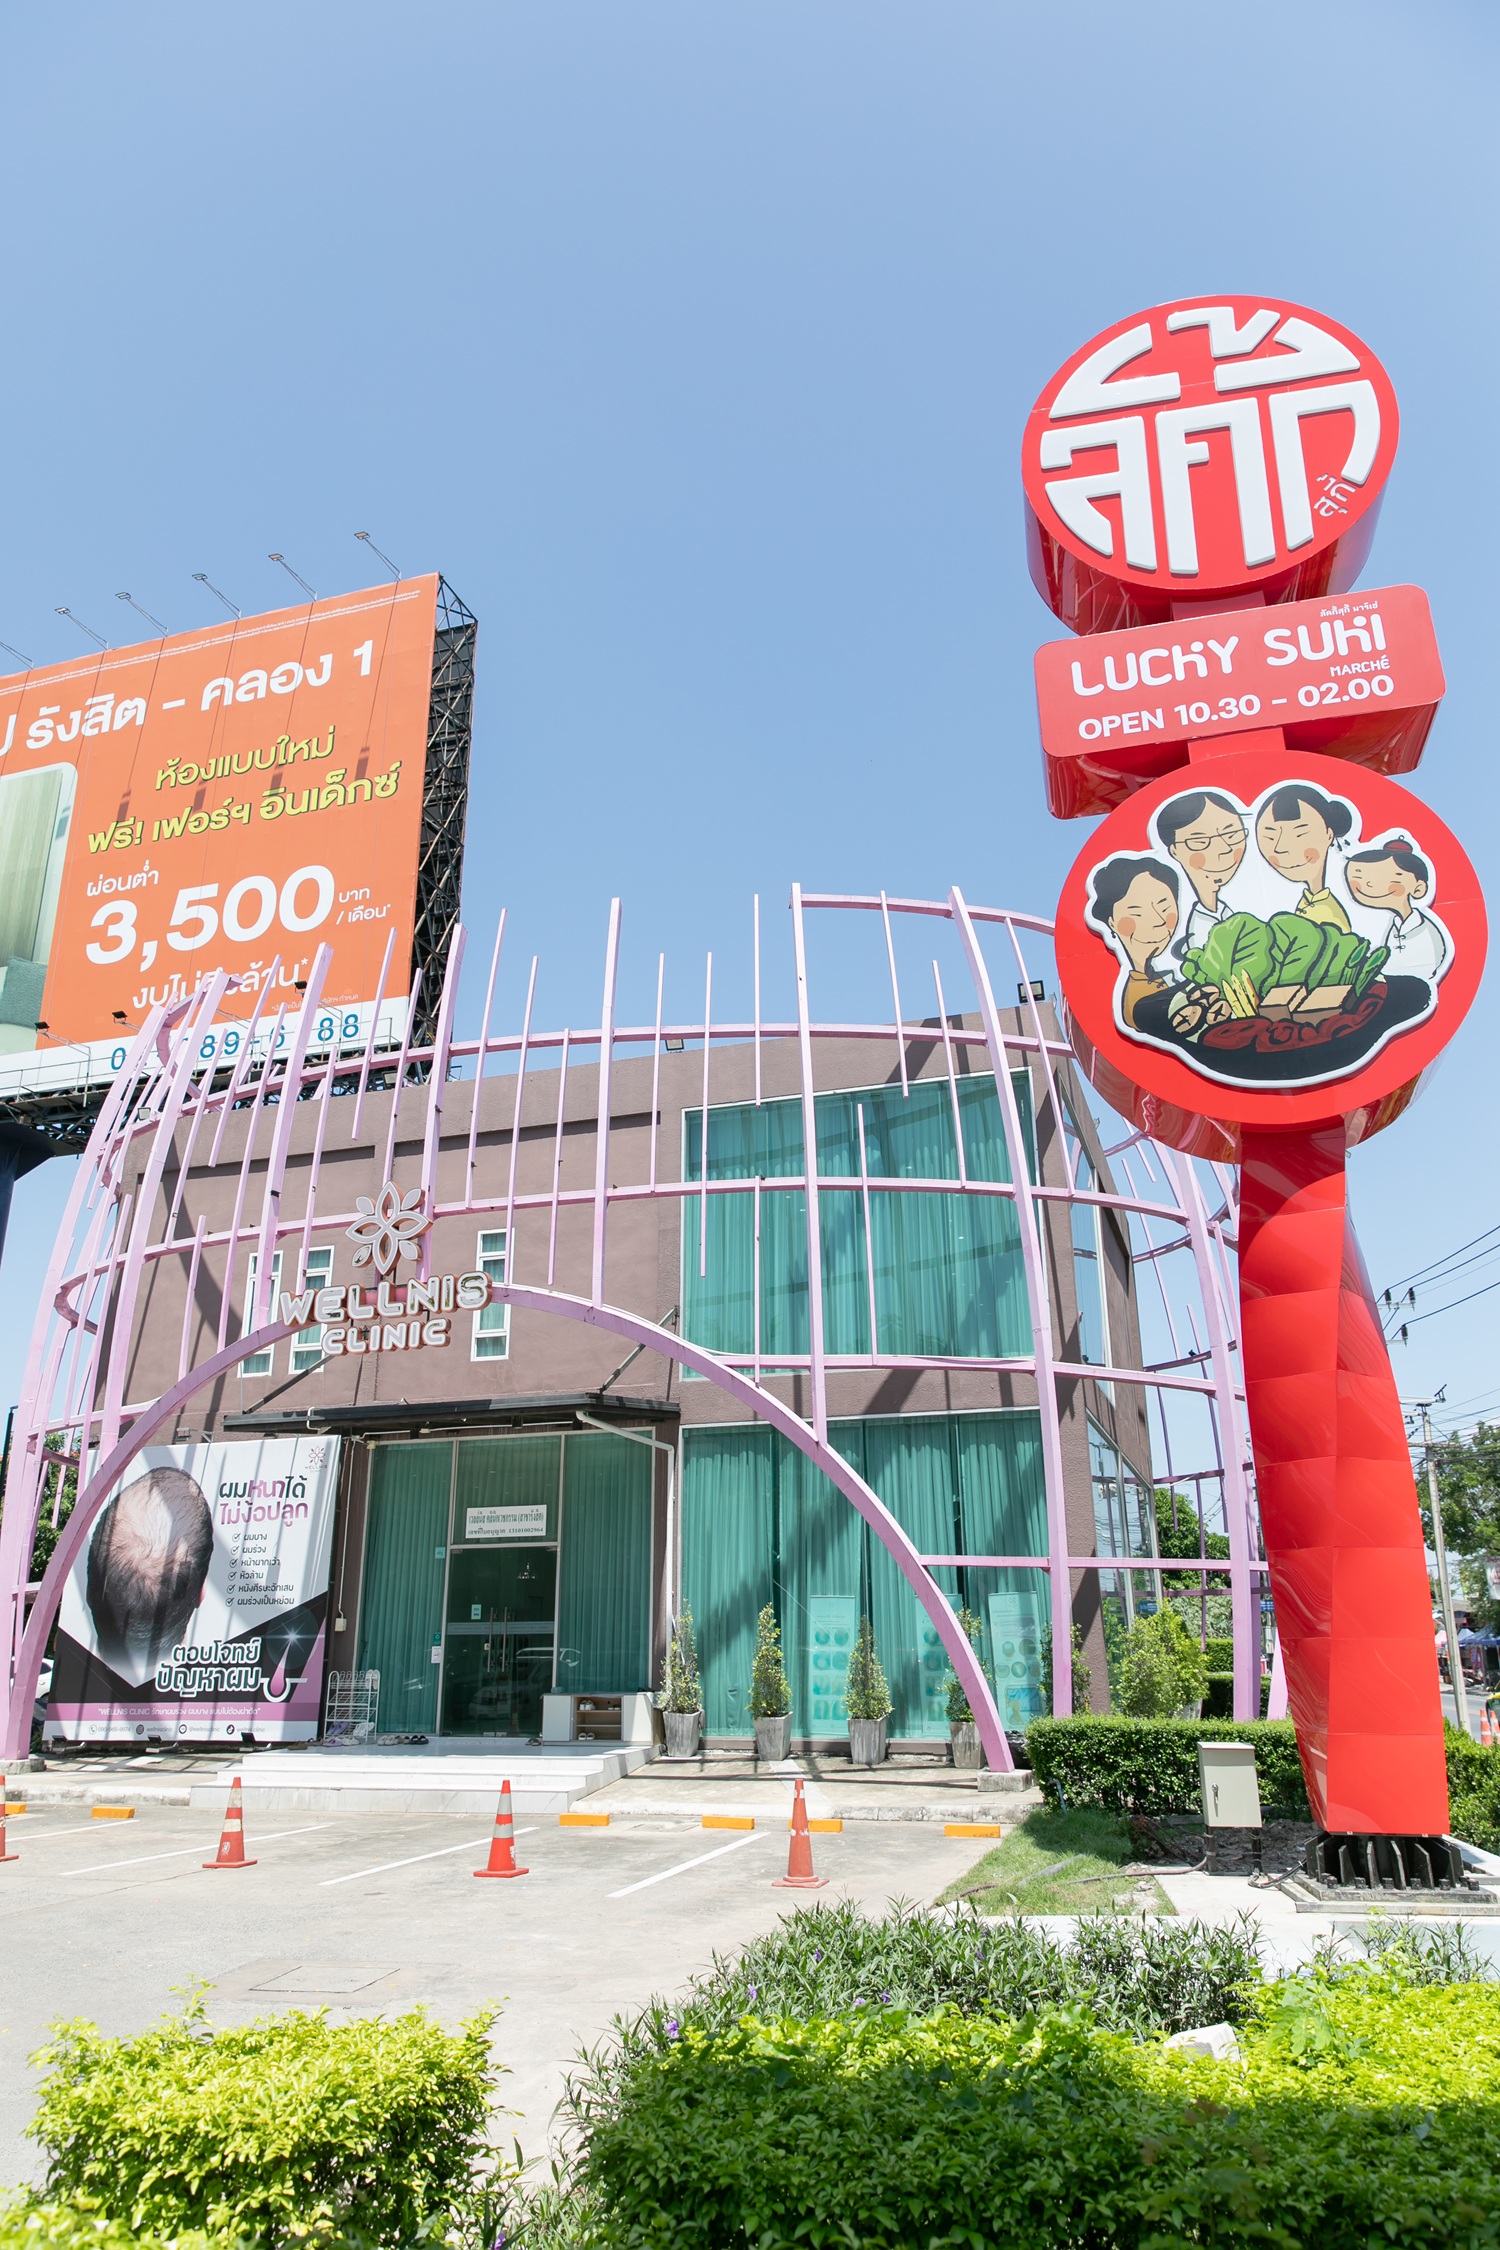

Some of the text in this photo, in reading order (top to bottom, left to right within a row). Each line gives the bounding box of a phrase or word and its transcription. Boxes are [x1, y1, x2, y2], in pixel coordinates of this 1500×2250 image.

[1330, 655, 1390, 677] MARCHÉ
[26, 693, 147, 749] รังสิต
[201, 653, 333, 712] คลอง
[353, 640, 373, 677] 1
[1079, 708, 1165, 740] OPEN
[1174, 694, 1261, 726] 10.30
[1297, 674, 1394, 707] 02.00
[155, 725, 336, 790] ห้องแบบใหม่
[88, 761, 402, 853] ฟรี! เฟอร์ฯ อินเด็กซ์
[86, 860, 159, 896] ผ่อนต่ำ
[339, 887, 371, 903] บาท
[86, 865, 335, 972] 3,500
[280, 1271, 492, 1327] WELLNIS
[322, 1318, 451, 1356] CLINIC
[219, 1475, 307, 1498] ผมหนาได้
[220, 1501, 309, 1527] ไม่ง้อปลูก
[242, 1544, 267, 1554] ผมร่วง
[243, 1533, 268, 1541] ผมบาง
[239, 1570, 264, 1580] หัวล้าน
[172, 1637, 261, 1664] ตอบโจทย์
[155, 1662, 262, 1697] ปัญหาผม
[129, 1708, 150, 1716] CLINIC
